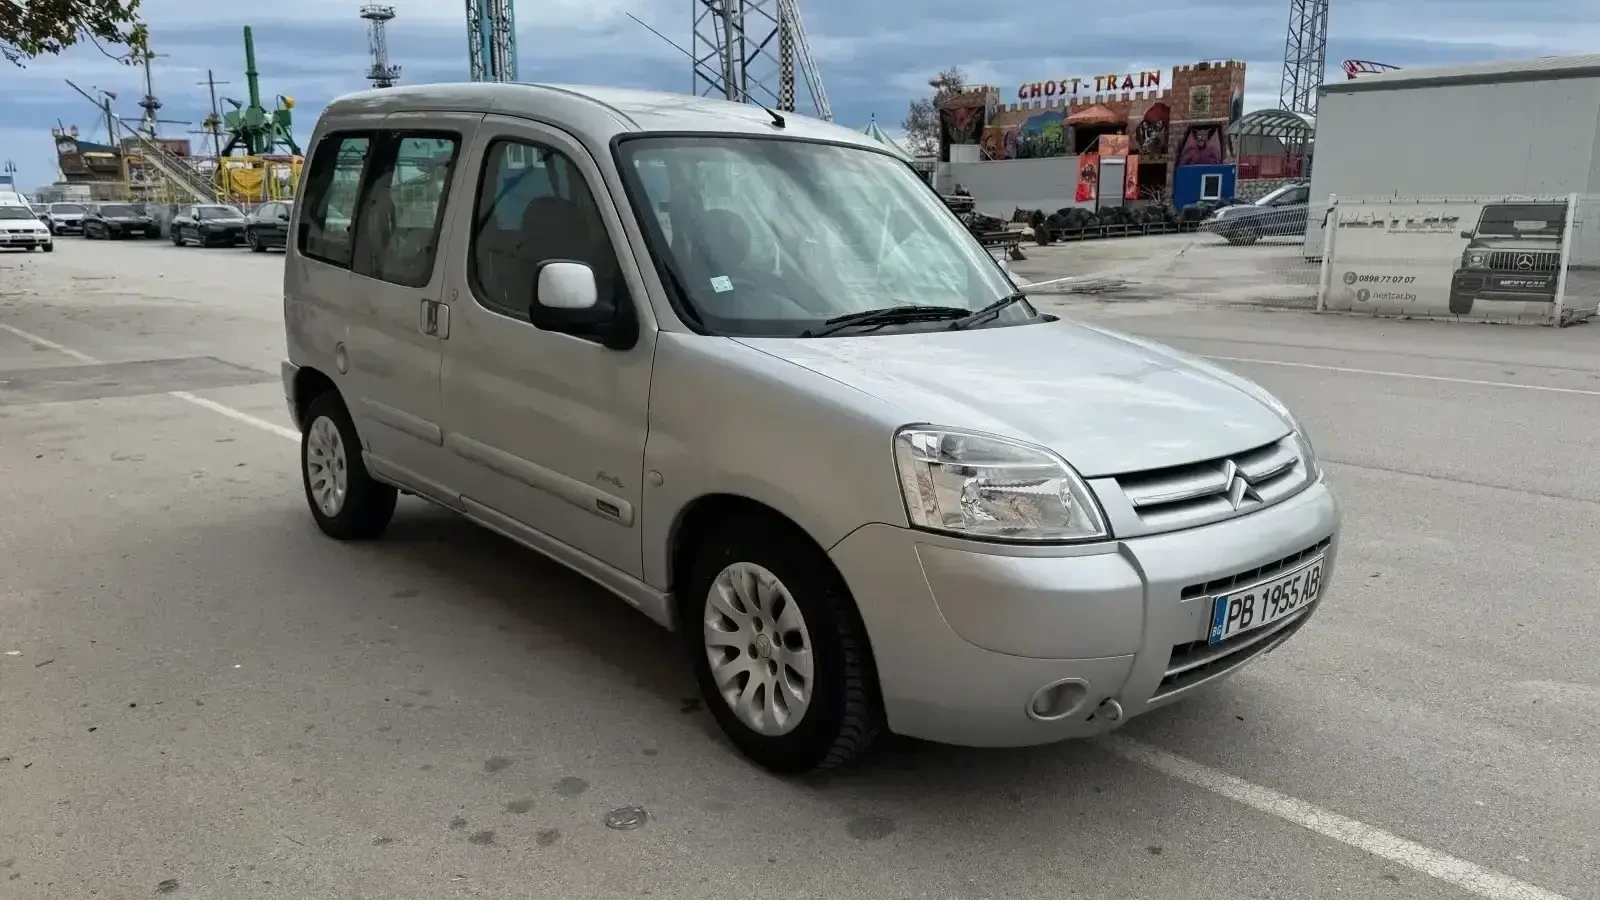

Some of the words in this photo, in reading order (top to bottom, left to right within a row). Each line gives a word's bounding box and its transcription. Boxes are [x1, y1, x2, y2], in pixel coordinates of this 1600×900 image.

[1359, 275, 1380, 283] 0898
[1404, 276, 1416, 284] 07
[1372, 291, 1417, 302] nextcar.bg
[1225, 594, 1255, 634] PB
[1261, 576, 1301, 621] 1955
[1300, 566, 1321, 604] AB
[1212, 625, 1222, 636] BG
